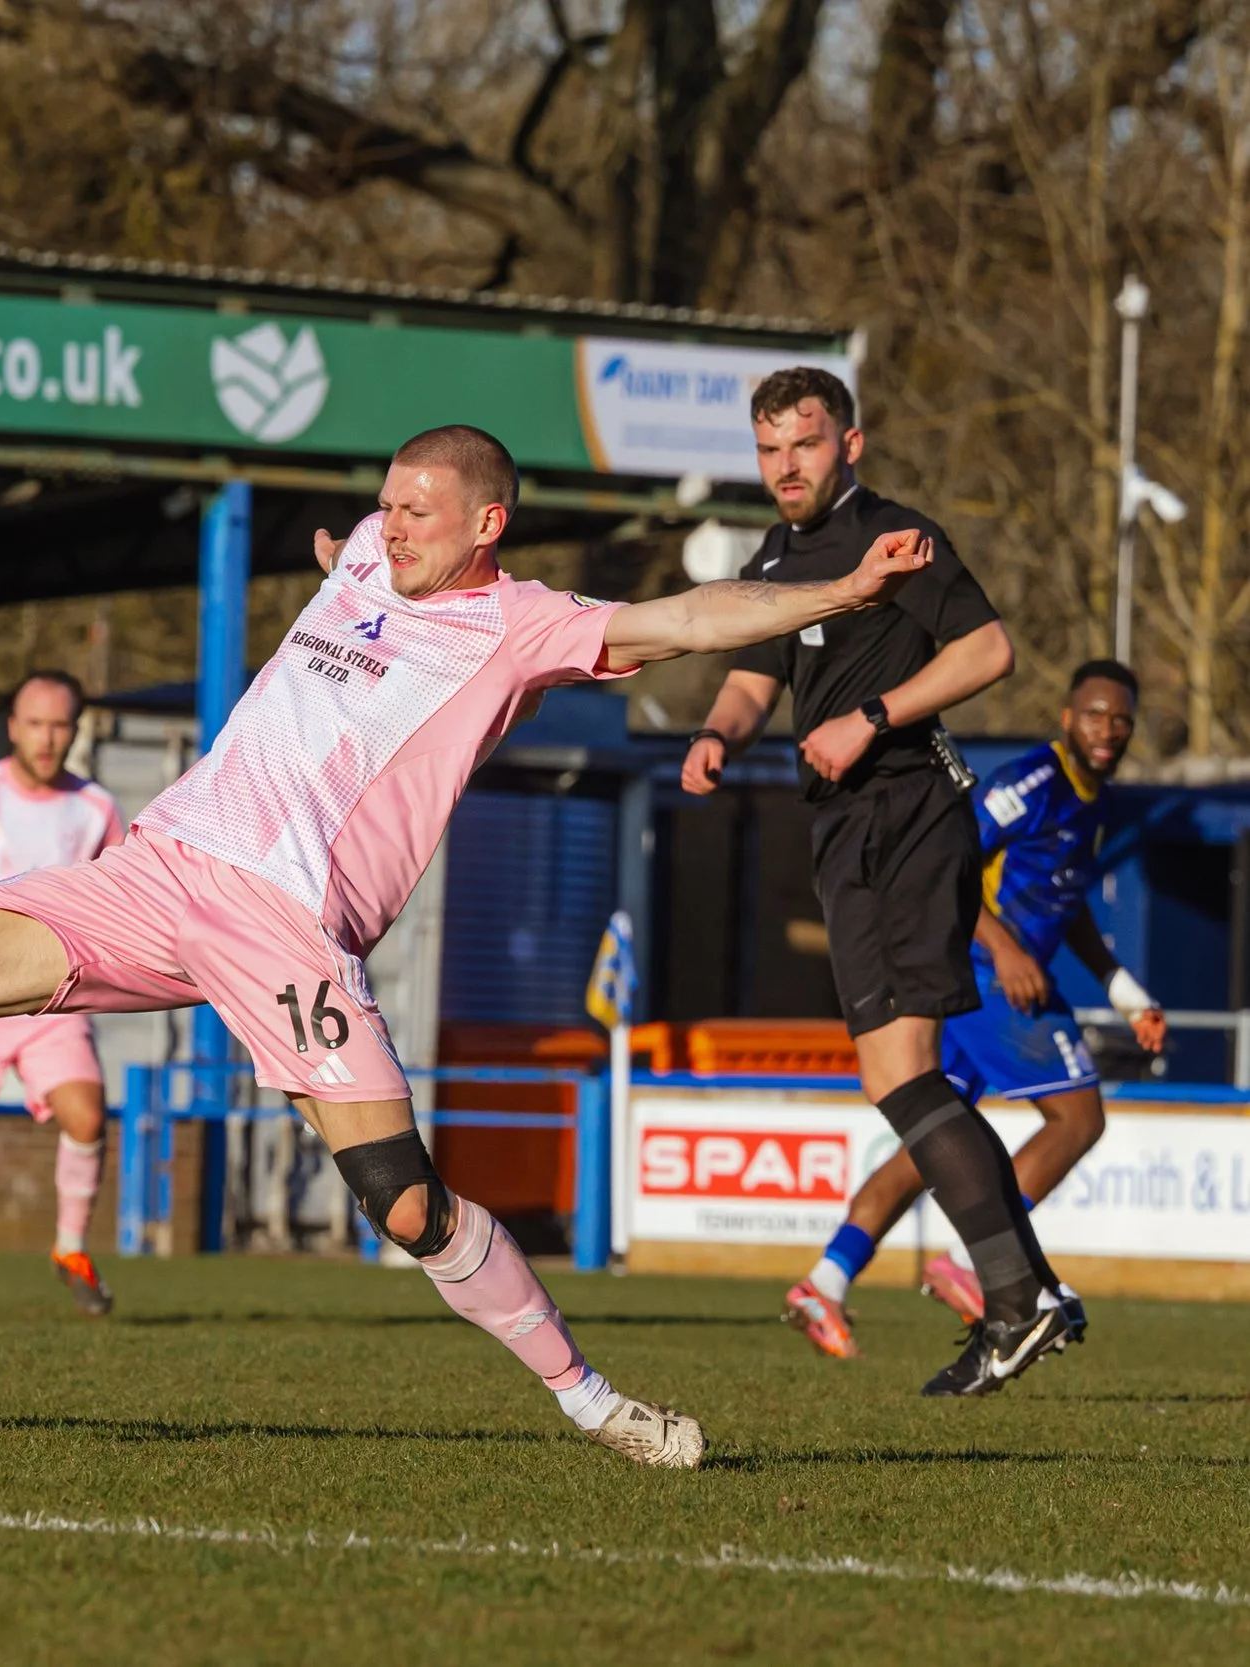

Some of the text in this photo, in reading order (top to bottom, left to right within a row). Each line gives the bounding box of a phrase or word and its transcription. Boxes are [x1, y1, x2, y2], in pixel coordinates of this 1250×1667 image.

[290, 630, 389, 678] REGIONAL STEELS
[307, 656, 349, 684] UK LTD.
[276, 980, 349, 1053] 16
[643, 1133, 845, 1194] SPAR
[1072, 1146, 1182, 1211] Smith
[1192, 1150, 1219, 1214] &
